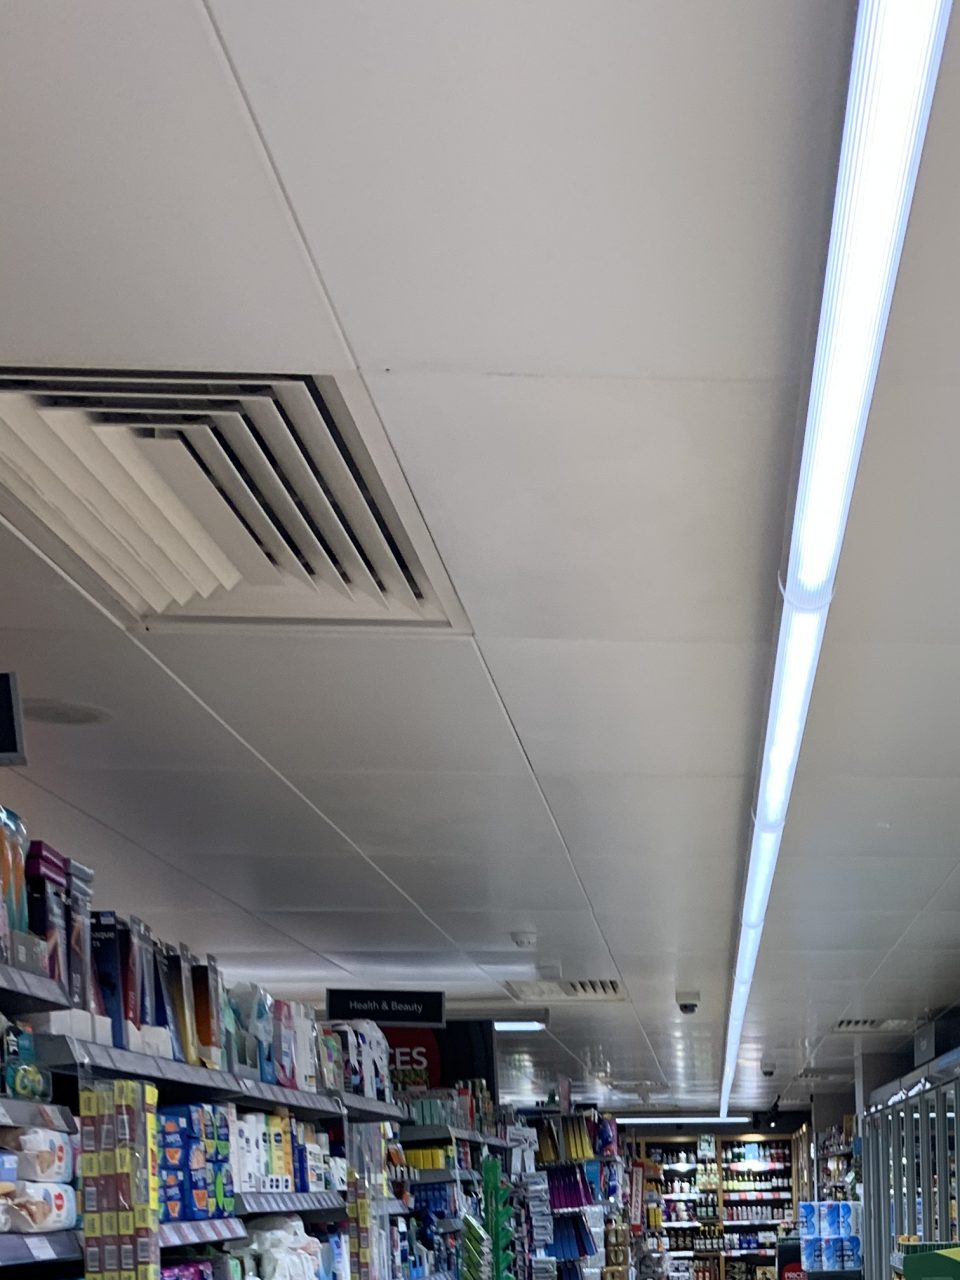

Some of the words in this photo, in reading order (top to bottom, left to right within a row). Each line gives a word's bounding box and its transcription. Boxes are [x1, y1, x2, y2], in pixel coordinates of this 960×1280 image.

[349, 1000, 379, 1011] Health
[381, 1001, 388, 1010] &
[391, 1001, 423, 1014] Beauty
